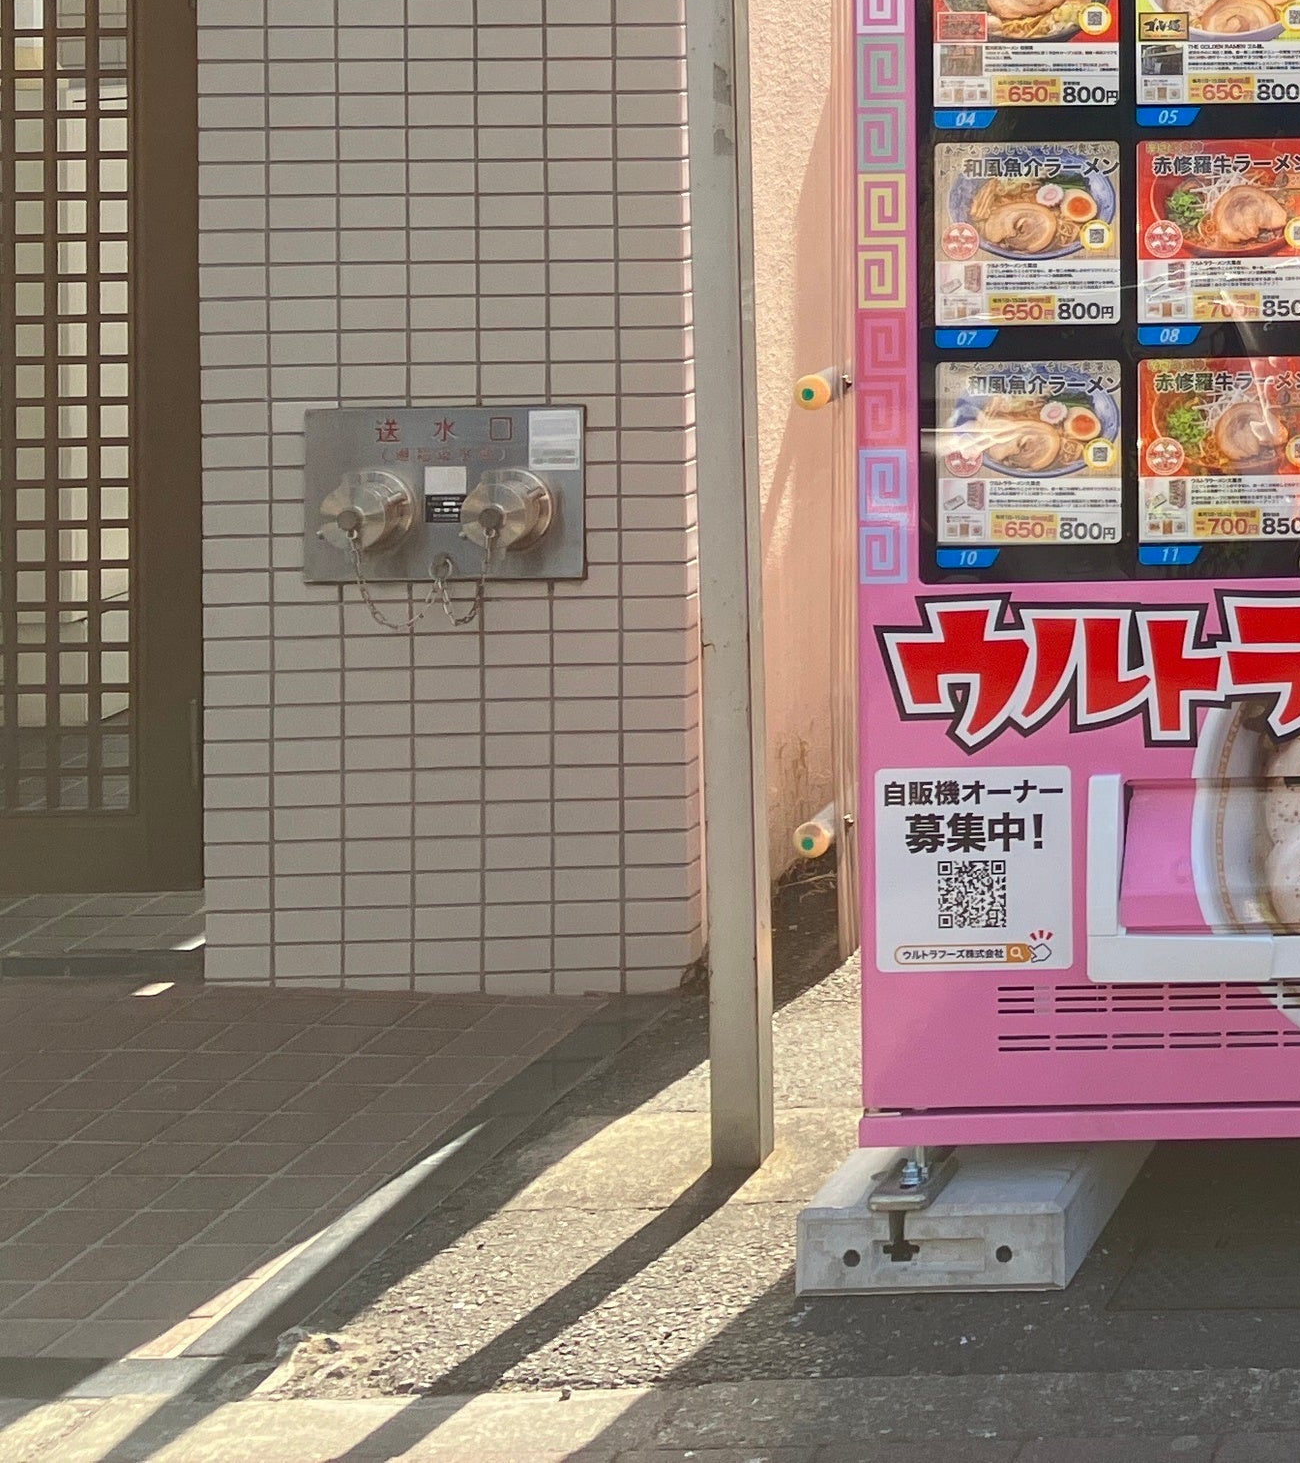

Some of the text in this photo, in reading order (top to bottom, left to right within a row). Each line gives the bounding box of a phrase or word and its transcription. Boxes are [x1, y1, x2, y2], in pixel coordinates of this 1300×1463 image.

[1008, 85, 1118, 103] 650円 800円
[1202, 84, 1254, 101] 650円
[955, 113, 975, 127] 04
[1158, 110, 1177, 124] 05
[964, 158, 1119, 177] 和風魚介ラーメン
[1002, 303, 1114, 321] 650円 800円
[957, 332, 976, 346] 07
[1160, 328, 1180, 342] 08
[969, 375, 1121, 395] 和風魚介ラーメン
[1004, 521, 1116, 540] 650円 800円
[1208, 518, 1258, 535] 700円
[958, 550, 977, 565] 10
[1161, 548, 1179, 562] 11
[884, 780, 1063, 806] 自販機オーナー
[905, 812, 1043, 853] 募集中!
[903, 948, 1004, 959] ウルトラフーズ株式会社
